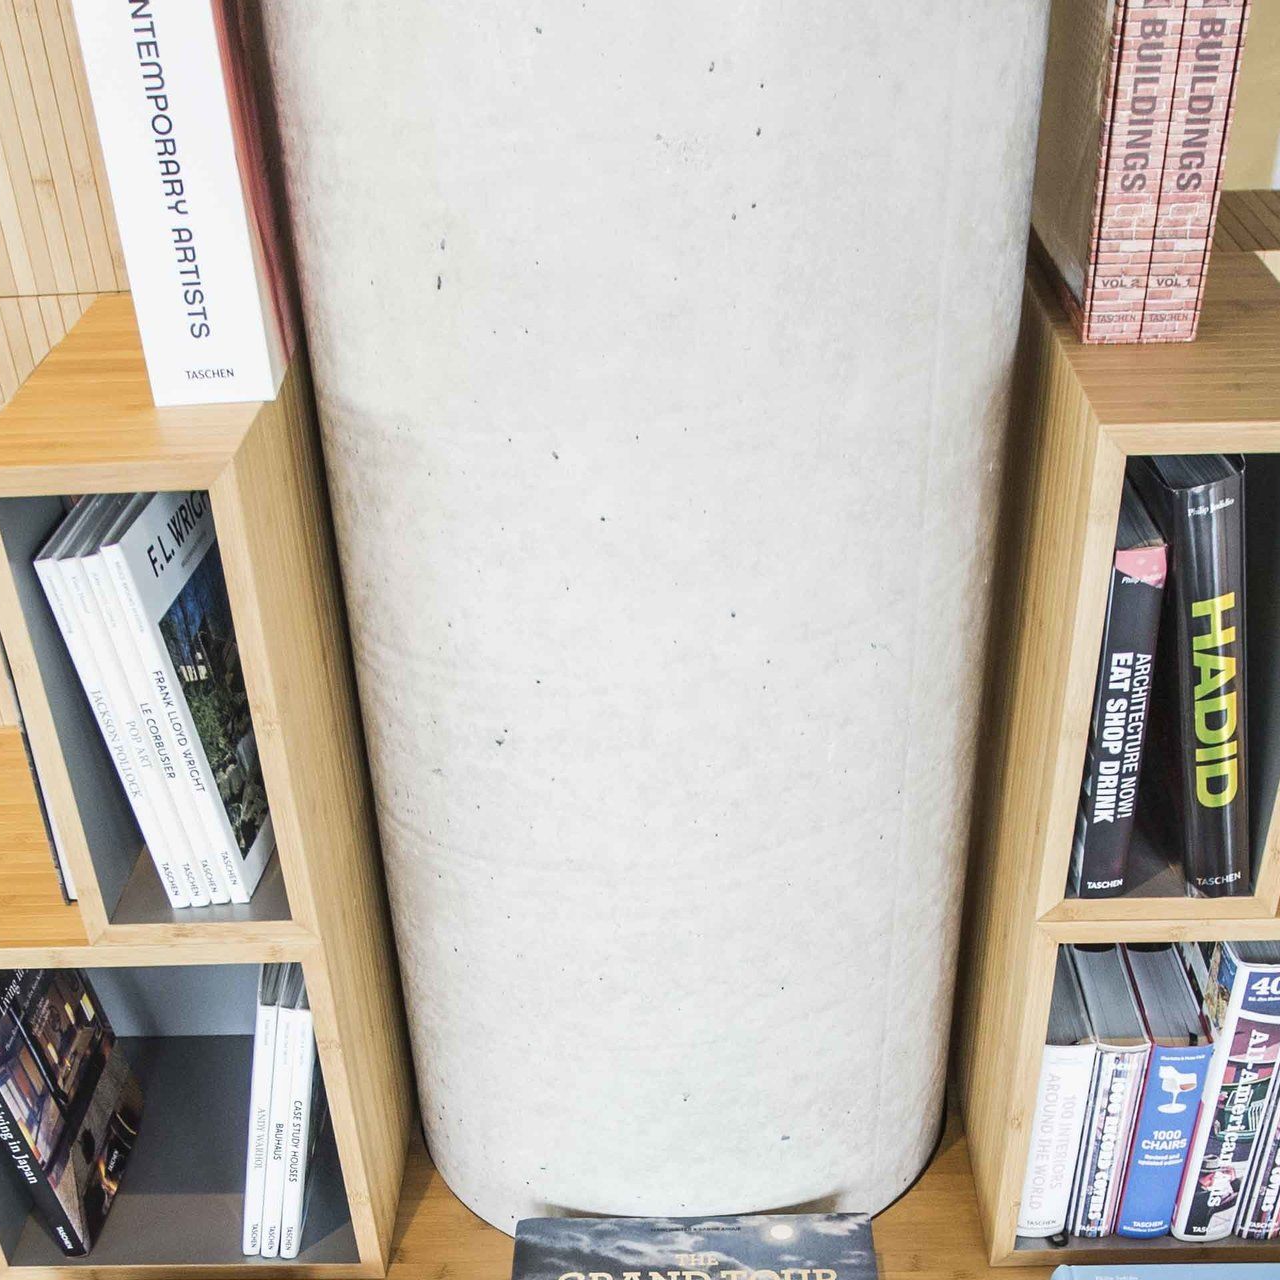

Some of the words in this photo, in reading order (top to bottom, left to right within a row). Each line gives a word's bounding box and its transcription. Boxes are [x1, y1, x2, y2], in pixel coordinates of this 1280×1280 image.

[1121, 18, 1167, 192] BUILDINGS
[1176, 17, 1226, 191] BUILDINGS
[172, 227, 210, 339] ARTISTS
[1102, 278, 1128, 287] VOL
[1156, 277, 1182, 287] VOL
[1096, 313, 1136, 322] TASCHEN
[1149, 313, 1188, 322] TASCHEN
[185, 368, 234, 380] TASCHEN
[1109, 652, 1134, 692] EAT
[1122, 653, 1152, 773] ARCHITECTURE
[1192, 591, 1238, 808] HADID
[90, 687, 119, 743] JACKSON
[114, 745, 142, 798] POLLOCK
[140, 703, 152, 714] LE
[146, 718, 176, 779] CORBUSIER
[153, 670, 175, 708] FRANK
[168, 711, 187, 746] LLOYD
[182, 748, 205, 792] WRIGHT
[1102, 698, 1128, 754] SHOP
[126, 720, 142, 743] POP
[137, 746, 152, 769] ART
[1093, 761, 1121, 824] DRINK
[1117, 776, 1136, 818] NOW!
[162, 862, 179, 896] TASCHEN
[182, 862, 200, 896] TASCHEN
[202, 859, 218, 893] TASCHEN
[221, 851, 238, 885] TASCHEN
[1087, 879, 1123, 890] TASCHEN
[1197, 872, 1241, 886] TASCHEN
[292, 1100, 303, 1121] CASE
[1041, 1073, 1060, 1133] AROUND
[255, 1108, 266, 1133] ANDY
[291, 1123, 301, 1150] STUDY
[1153, 1130, 1181, 1140] 1000
[9, 1141, 20, 1153] in
[273, 1123, 284, 1160] BAUHAUS
[1036, 1134, 1052, 1164] THE
[1141, 1138, 1187, 1150] CHAIRS
[12, 1154, 38, 1184] Japan
[289, 1151, 299, 1183] HOUSES
[1029, 1164, 1047, 1212] WORLD
[675, 1253, 719, 1266] THE
